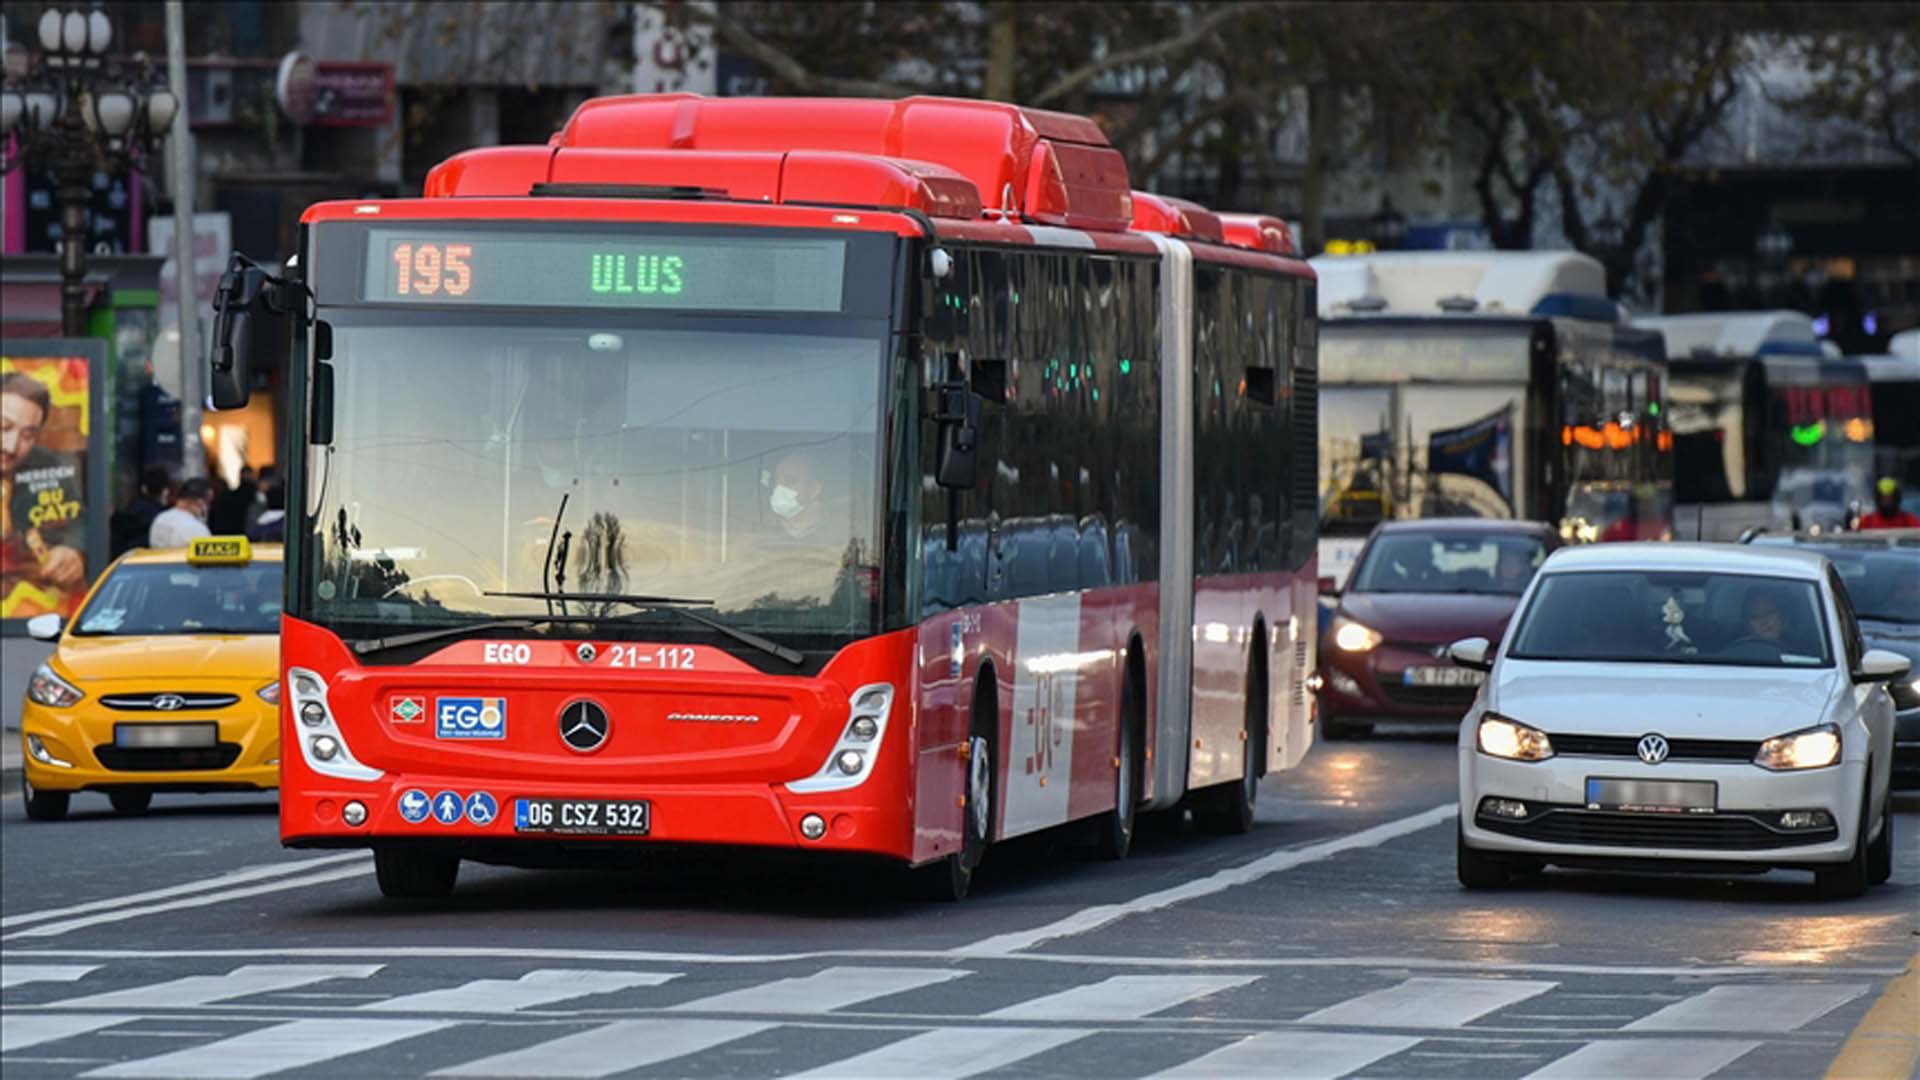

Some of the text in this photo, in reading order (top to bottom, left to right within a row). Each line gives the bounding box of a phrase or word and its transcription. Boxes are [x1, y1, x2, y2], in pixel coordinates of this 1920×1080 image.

[394, 243, 472, 295] 195
[591, 254, 684, 294] ULUS
[38, 488, 64, 505] BU
[28, 502, 80, 528] ÇAY?
[484, 643, 531, 665] EGO
[611, 646, 695, 670] 21-112
[440, 705, 501, 729] EGO
[529, 803, 643, 827] 06 CSZ 532
